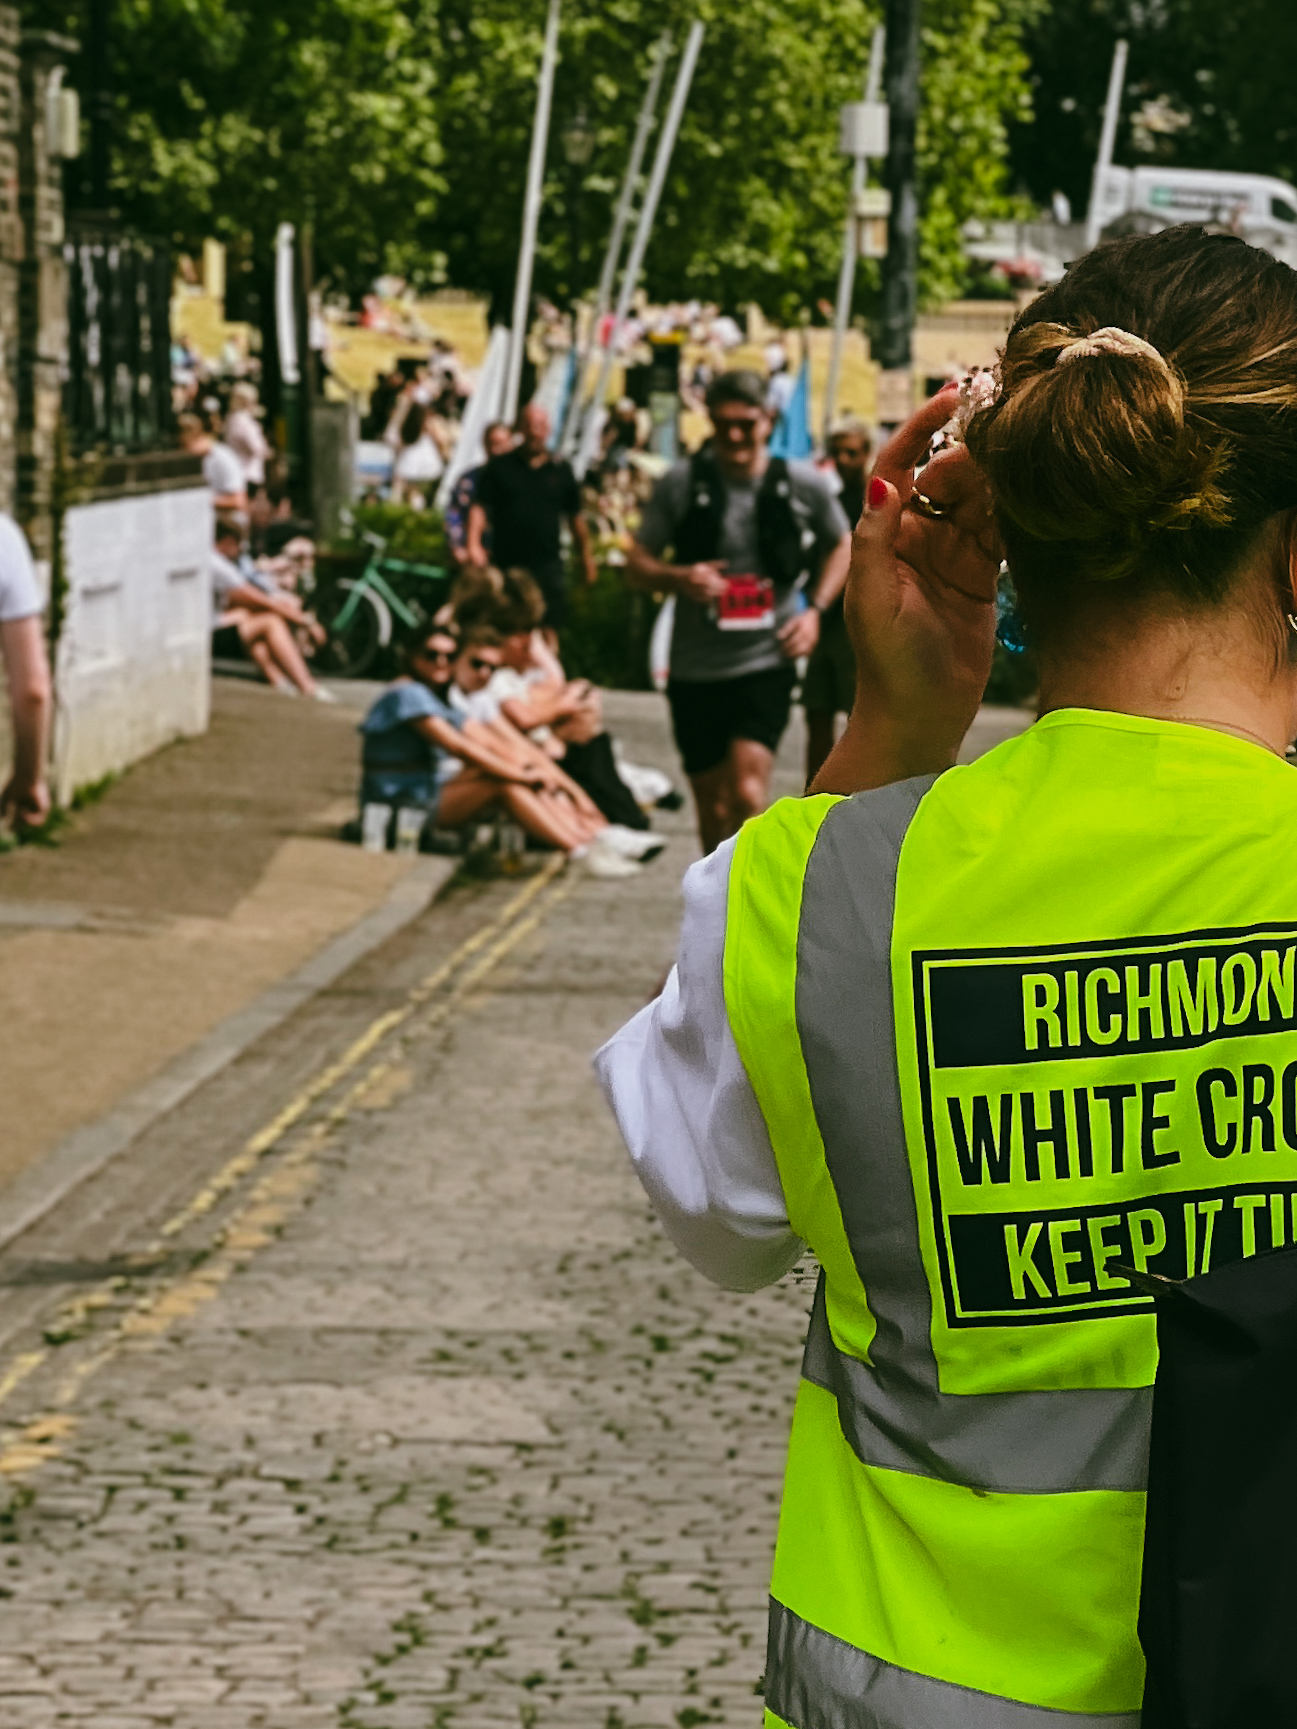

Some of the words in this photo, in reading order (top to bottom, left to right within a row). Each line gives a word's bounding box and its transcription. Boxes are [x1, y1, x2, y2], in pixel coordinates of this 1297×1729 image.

[947, 1079, 1180, 1186] WHITE
[1004, 1208, 1166, 1299] KEEP
[1183, 1199, 1223, 1279] IT
